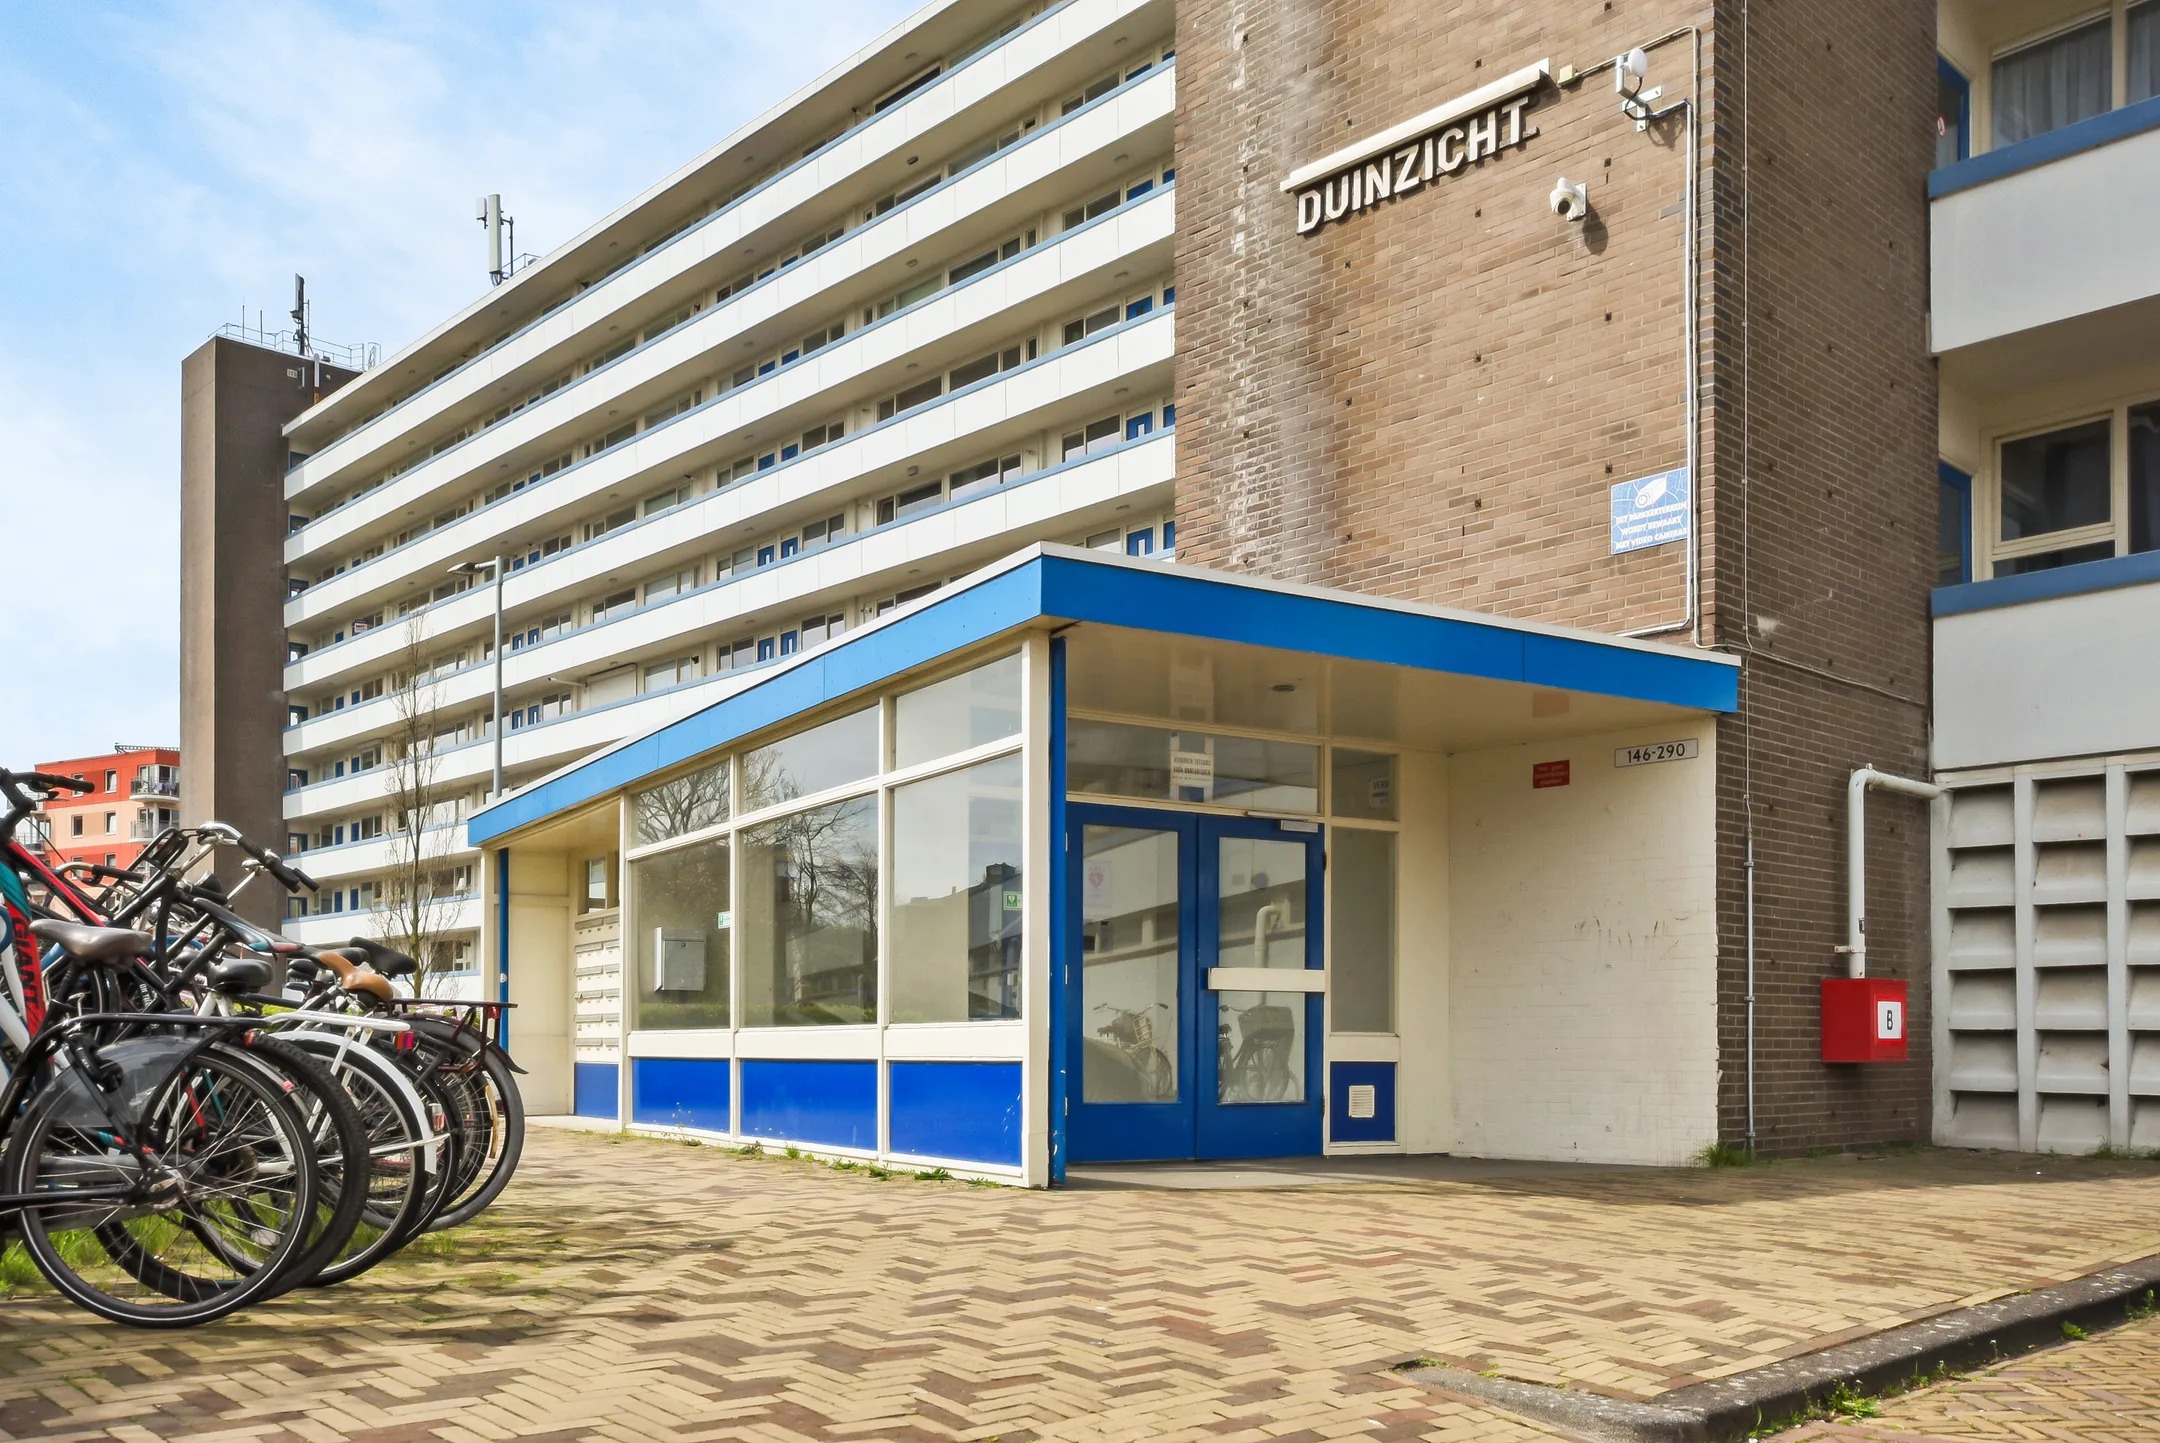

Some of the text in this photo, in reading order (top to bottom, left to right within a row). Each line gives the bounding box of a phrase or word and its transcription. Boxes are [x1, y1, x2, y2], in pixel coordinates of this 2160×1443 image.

[1297, 97, 1529, 235] DUINZICHT
[1631, 535, 1653, 547] VIDEO
[1627, 743, 1686, 763] 146-290
[12, 916, 41, 1010] GIANT
[1886, 1009, 1893, 1030] B
